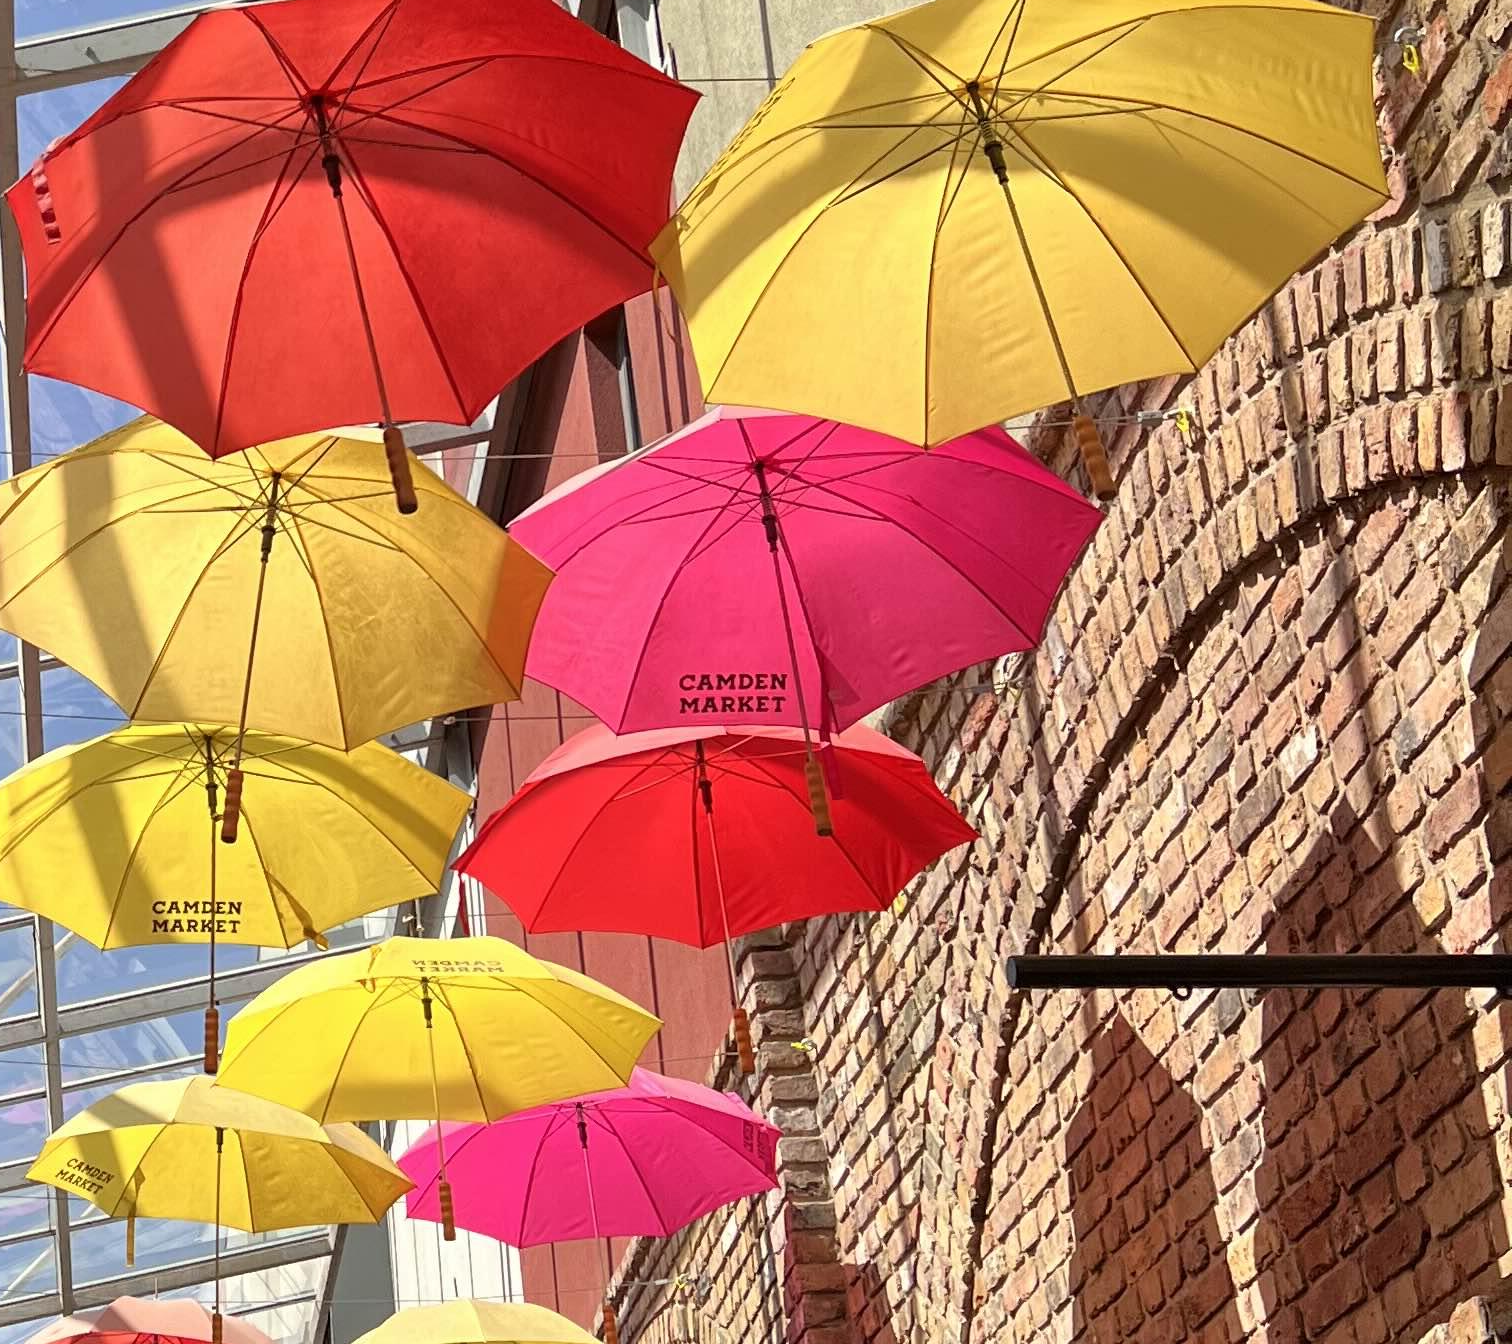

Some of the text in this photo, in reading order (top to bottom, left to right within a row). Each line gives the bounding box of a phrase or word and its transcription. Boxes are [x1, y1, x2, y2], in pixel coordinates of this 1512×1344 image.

[679, 673, 788, 691] CAMDEN
[679, 696, 787, 714] MARKET
[152, 900, 243, 915] CAMDEN
[151, 919, 241, 933] MARKET
[66, 1158, 115, 1184] CAMDEN
[55, 1169, 104, 1195] MARKET
